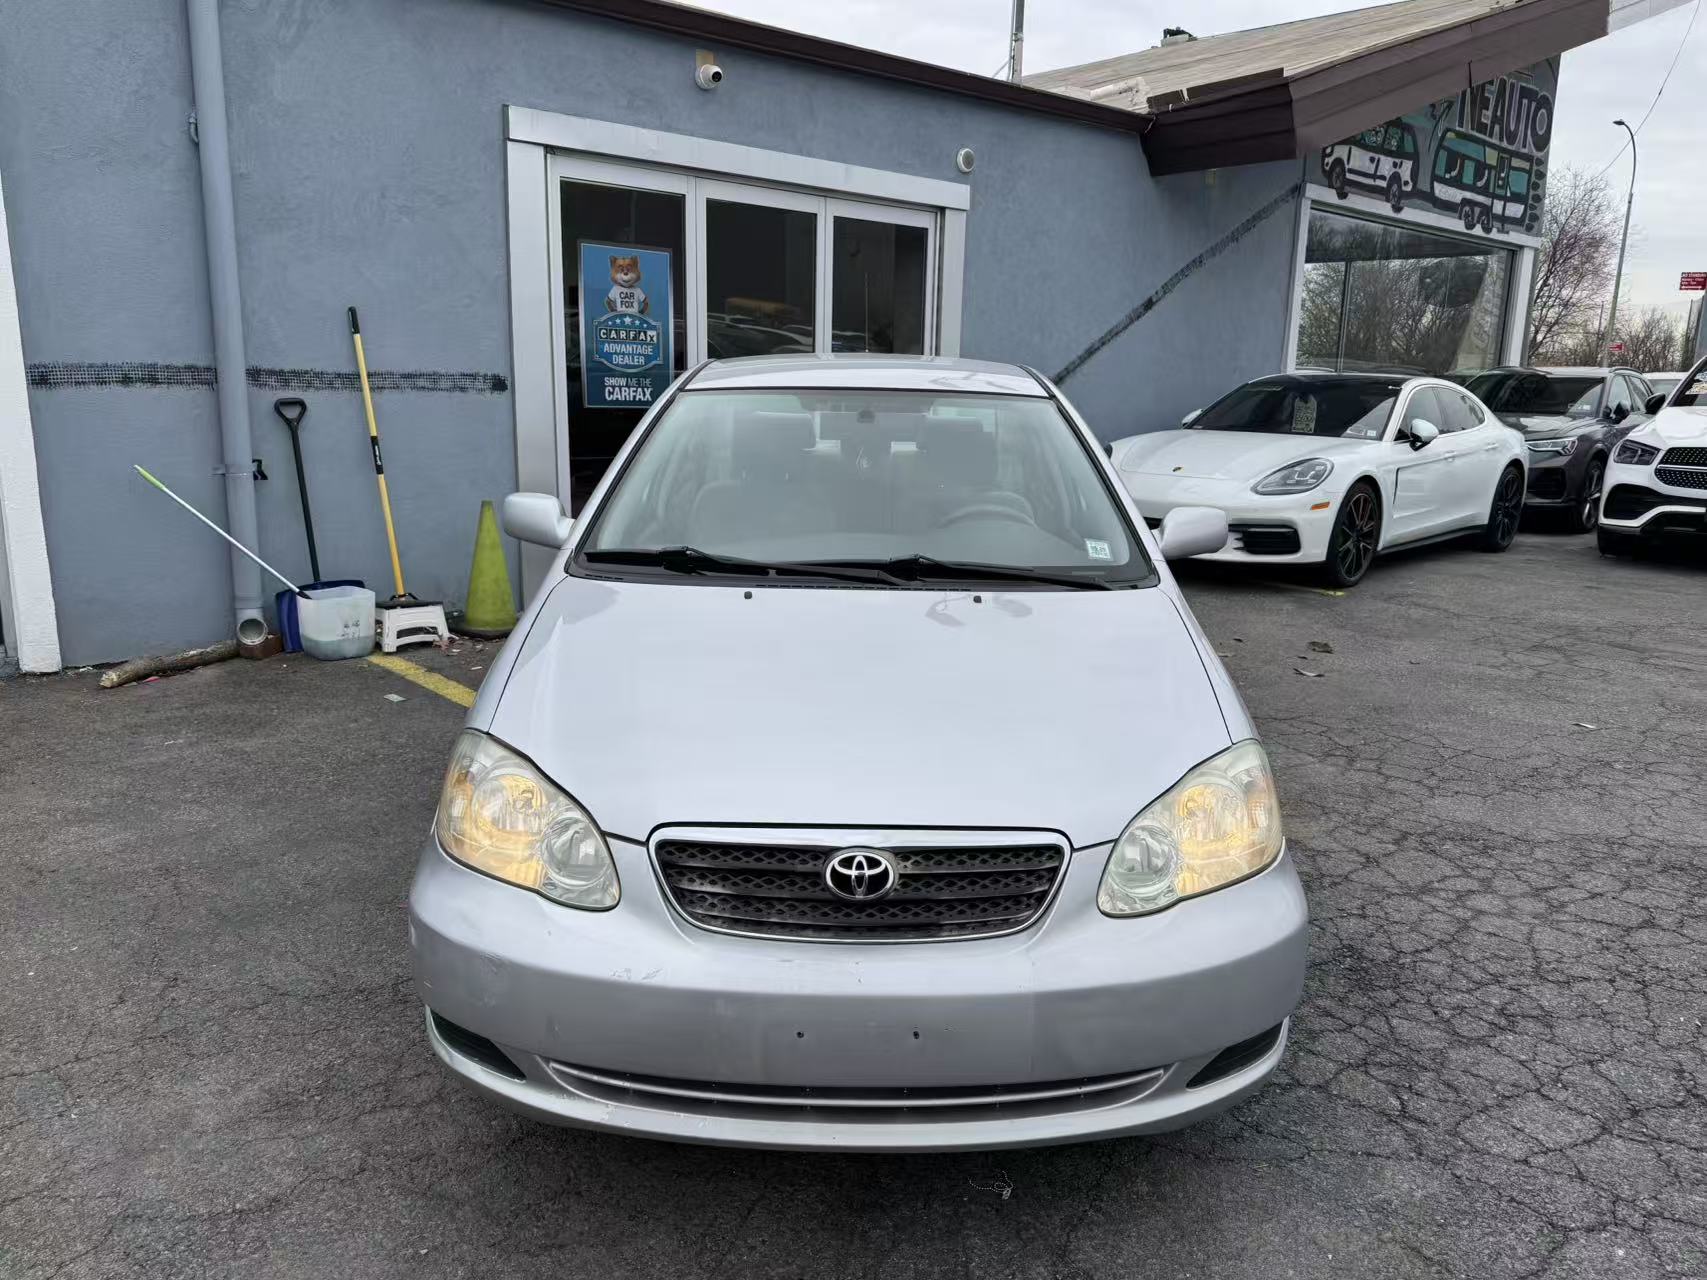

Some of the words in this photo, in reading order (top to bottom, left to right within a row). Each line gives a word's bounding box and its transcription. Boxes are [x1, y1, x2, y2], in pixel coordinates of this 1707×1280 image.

[619, 291, 635, 300] CAR
[620, 300, 635, 309] FOX
[600, 329, 656, 343] CARFAX
[603, 343, 653, 355] ADVANTAGE
[612, 354, 645, 365] DEALER
[604, 376, 627, 387] SHOW
[627, 377, 639, 387] ME
[640, 377, 652, 388] THE
[605, 386, 652, 402] CARFAX
